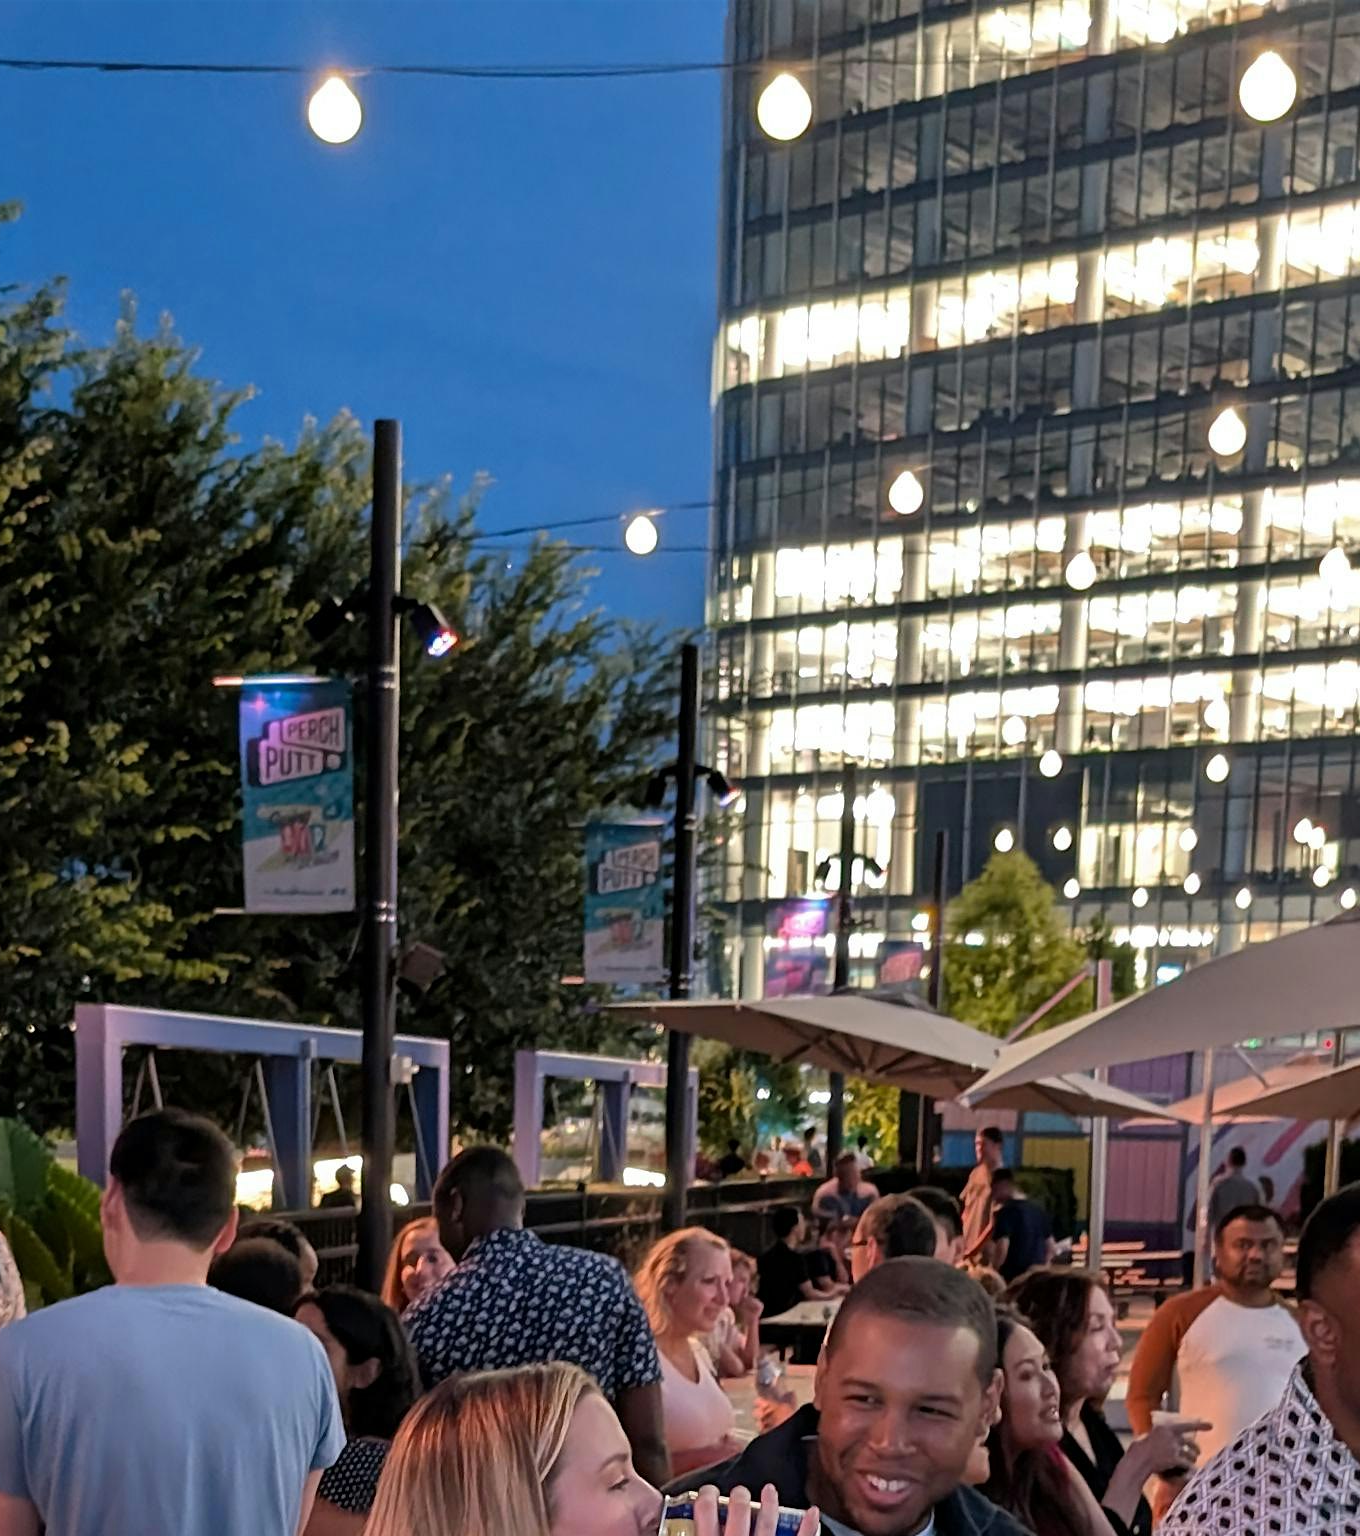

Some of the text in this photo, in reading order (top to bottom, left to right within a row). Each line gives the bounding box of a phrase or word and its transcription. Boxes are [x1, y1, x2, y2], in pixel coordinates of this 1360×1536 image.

[287, 714, 340, 747] PERCH
[266, 746, 317, 779] PUTT
[602, 867, 639, 891] PUTT
